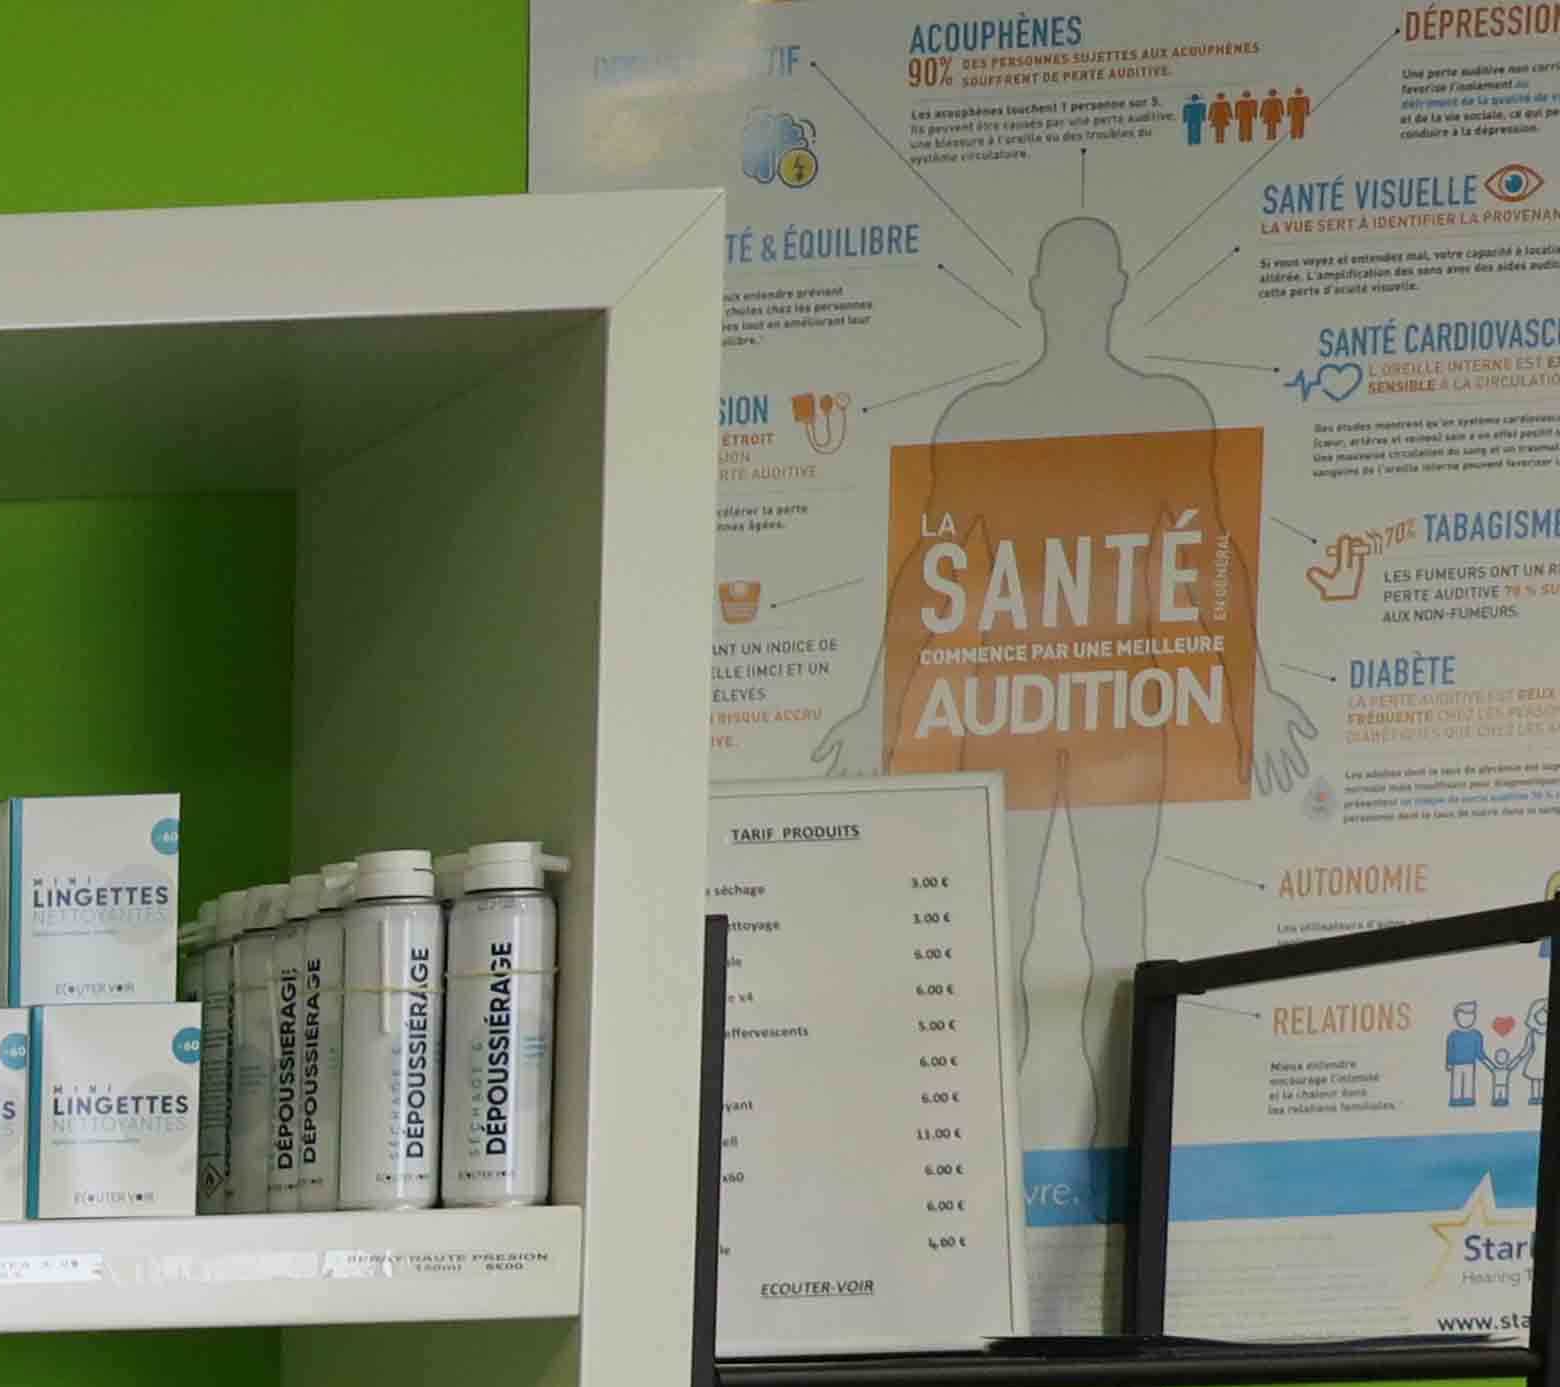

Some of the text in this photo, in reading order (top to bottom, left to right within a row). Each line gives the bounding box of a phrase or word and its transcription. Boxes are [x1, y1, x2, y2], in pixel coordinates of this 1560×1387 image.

[909, 11, 1083, 54] ACOUPHÈNES
[907, 57, 953, 88] 90%
[1262, 174, 1478, 215] SANTÉ VISUELLE
[761, 223, 921, 263] & ÉQUILIBRE
[1319, 317, 1560, 358] SANTÉ CARDIOVASC
[921, 512, 957, 537] LA
[921, 506, 1203, 634] SANTÉ
[1383, 563, 1545, 584] LES FUMEURS ONT UN
[1383, 585, 1500, 603] PERTE AUDITIVE
[1382, 609, 1410, 624] AUX
[920, 635, 1225, 665] COMMENCE PAR UNE MEILLEURE
[1349, 650, 1457, 689] DIABÈTE
[913, 664, 1225, 739] AUDITION
[731, 825, 860, 842] TARIF PRODUITS
[33, 886, 169, 908] LINGETTES
[714, 883, 765, 899] séchage
[1278, 863, 1428, 898] AUTONOMIE
[1272, 1001, 1412, 1036] RELATIONS
[303, 959, 323, 1164] DÉPOUSSIÉRAGE
[403, 947, 430, 1159] DÉPOUSSIÉRAGE
[482, 941, 513, 1156] DÉPOUSSIÉRAGE
[53, 1084, 112, 1095] MINI
[53, 1095, 189, 1116] LINGETTES
[760, 1279, 874, 1297] ECOUTER-VOIR
